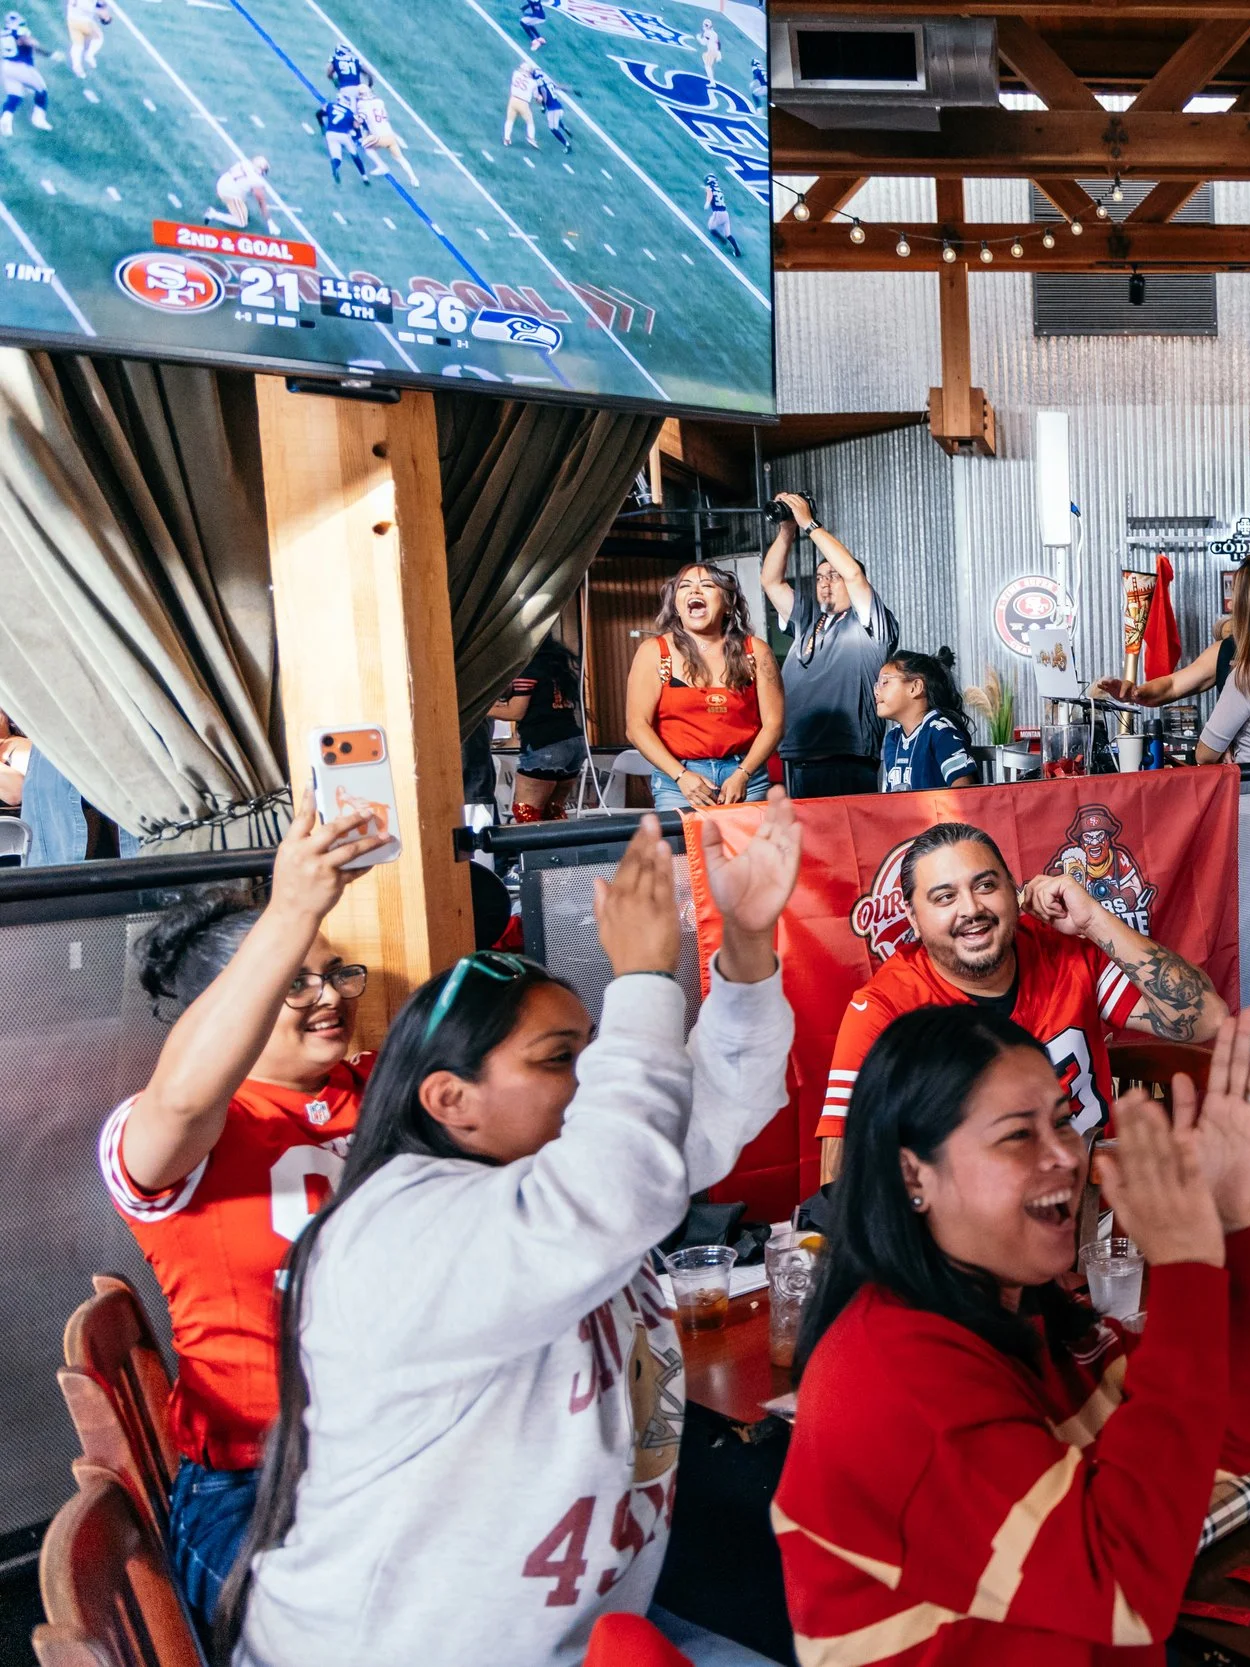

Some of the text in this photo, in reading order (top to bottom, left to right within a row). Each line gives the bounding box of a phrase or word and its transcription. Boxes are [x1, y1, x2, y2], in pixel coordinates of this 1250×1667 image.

[176, 228, 294, 261] 2ND & GOAL
[5, 262, 56, 284] 1 INT
[240, 266, 301, 313] 21
[321, 277, 392, 305] 11:04
[339, 304, 375, 320] 4TH
[407, 292, 468, 335] 26
